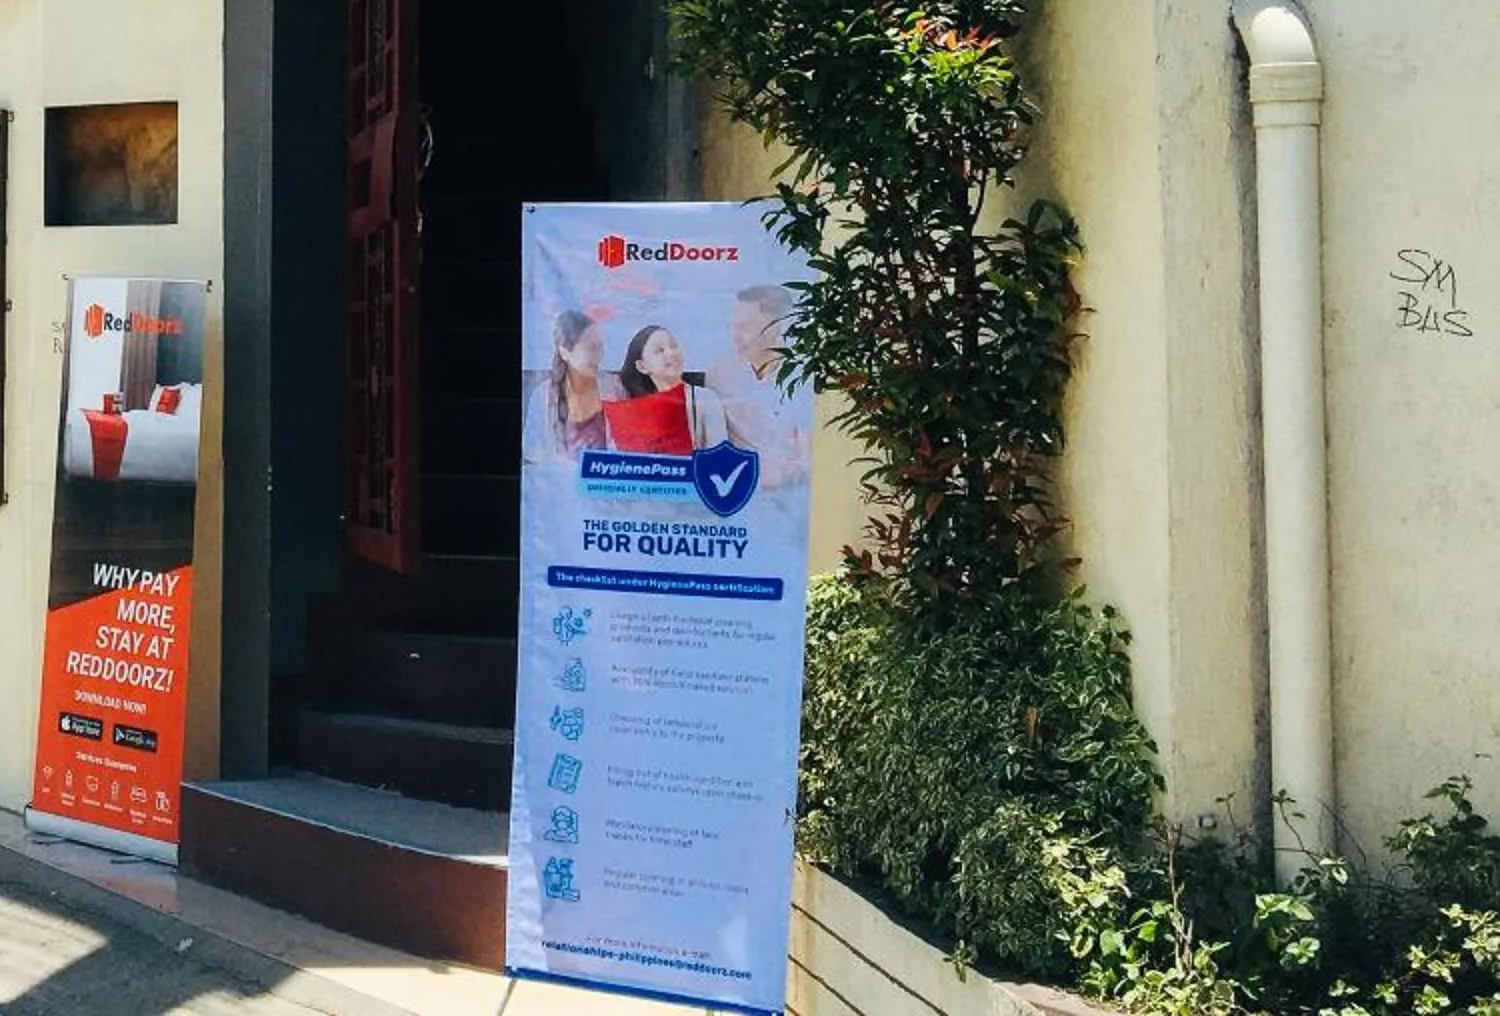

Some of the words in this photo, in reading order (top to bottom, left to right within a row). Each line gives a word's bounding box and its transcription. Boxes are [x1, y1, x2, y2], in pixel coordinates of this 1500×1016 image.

[626, 241, 739, 262] RedDoorz
[103, 312, 184, 335] RedDoorz
[1395, 291, 1473, 337] BUS
[589, 461, 687, 478] HygienePass
[583, 519, 609, 531] THE
[612, 521, 669, 534] GOLDEN
[671, 523, 748, 539] STANDARD
[583, 532, 631, 553] FOR
[637, 535, 749, 559] QUALITY
[93, 563, 140, 591] WHY
[139, 571, 180, 597] PAY
[555, 571, 573, 582] The
[116, 598, 176, 635] MORE,
[95, 625, 145, 655] STAY
[145, 635, 175, 660] AT
[66, 651, 175, 693] REDDOORZ!
